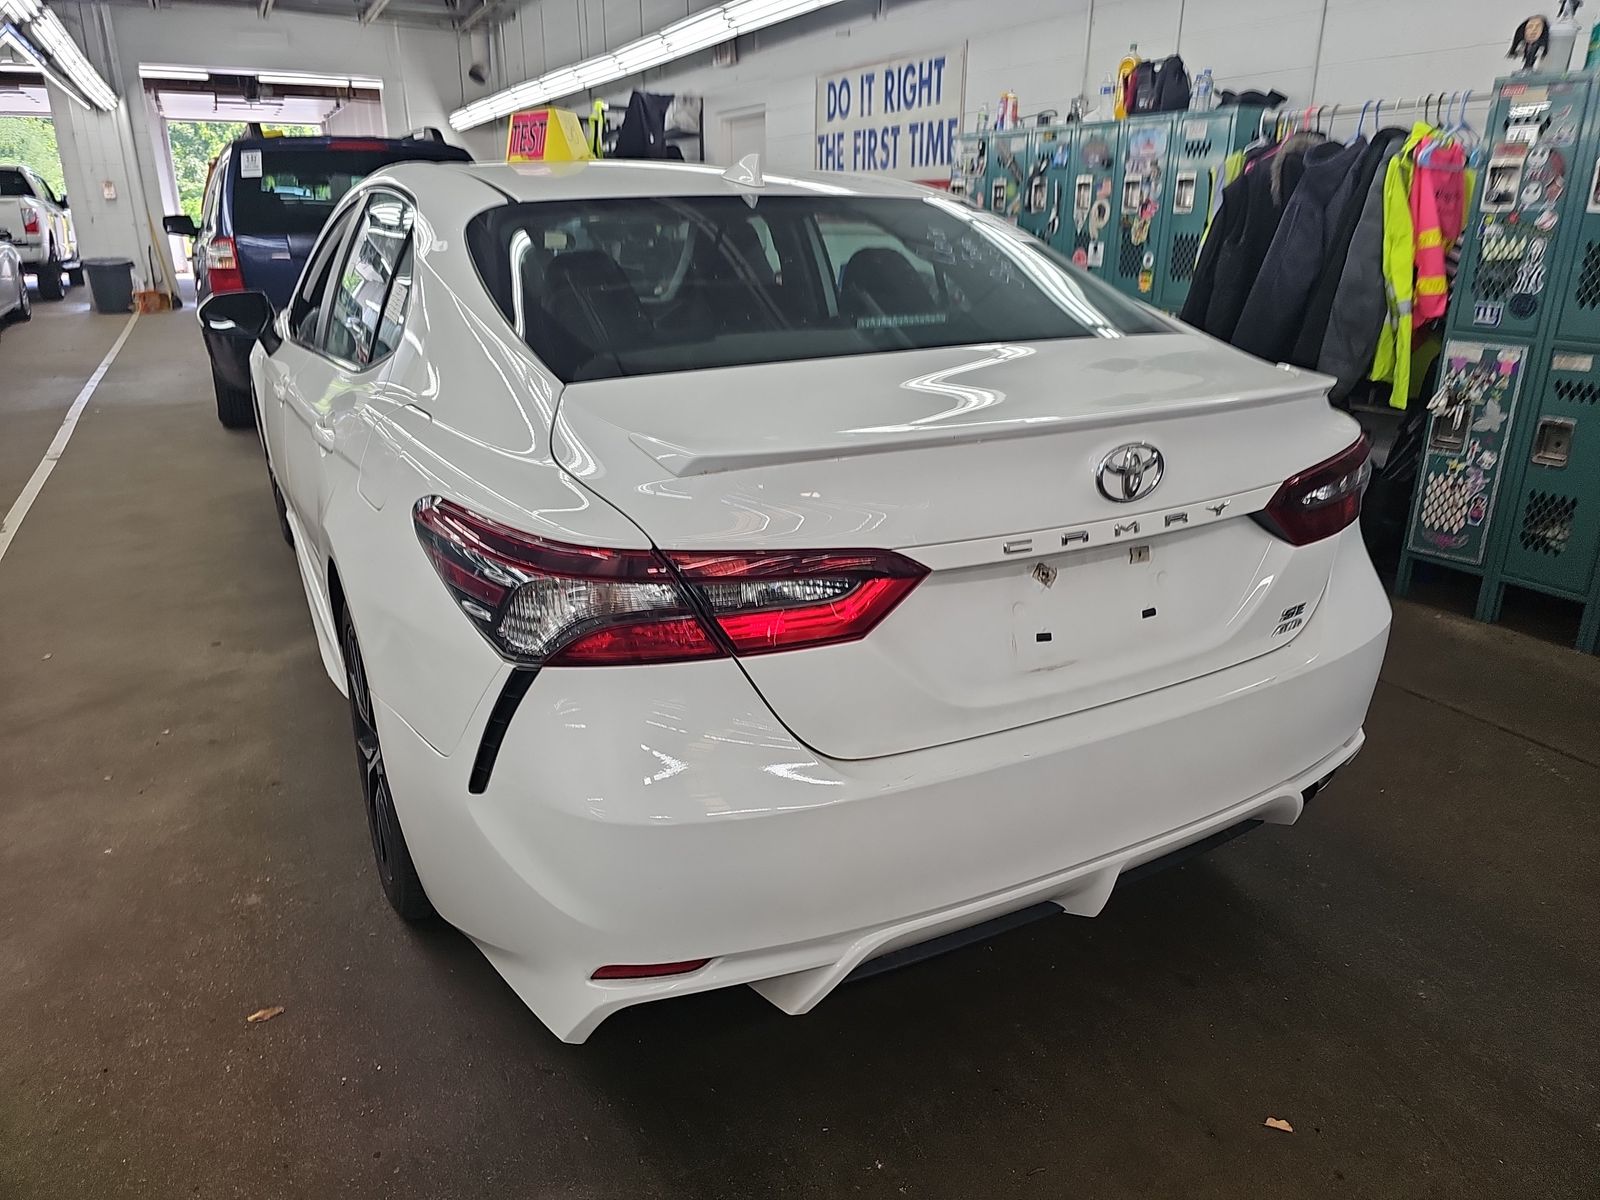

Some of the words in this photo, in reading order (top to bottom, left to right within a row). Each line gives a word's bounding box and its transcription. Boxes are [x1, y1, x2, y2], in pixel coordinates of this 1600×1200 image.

[827, 78, 851, 123] DO
[860, 72, 875, 118] IT
[884, 56, 946, 115] RIGHT
[511, 121, 547, 154] TEST
[818, 132, 844, 171] THE
[853, 125, 900, 172] FIRST
[1002, 499, 1231, 555] CAMRY
